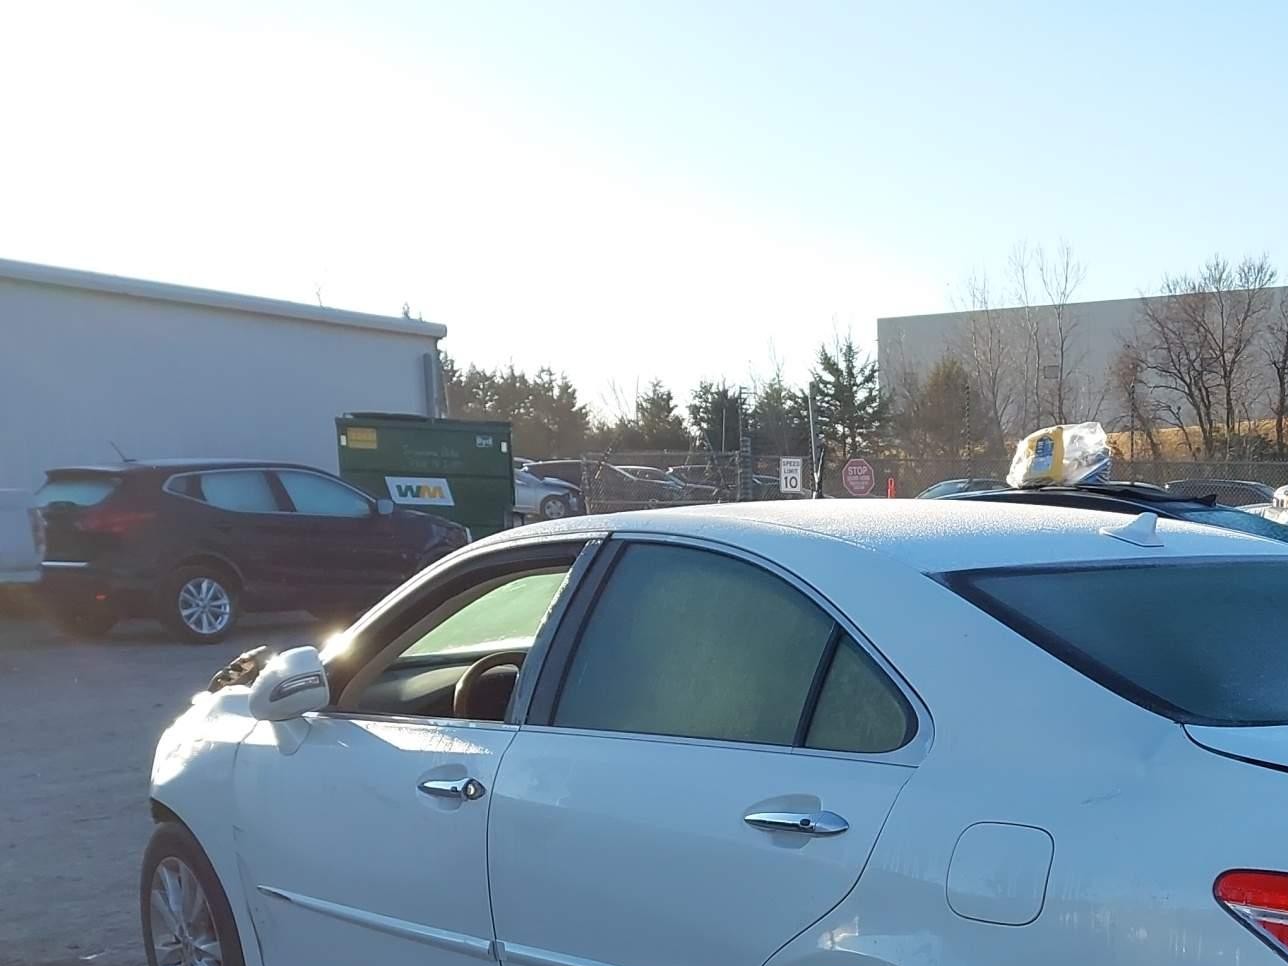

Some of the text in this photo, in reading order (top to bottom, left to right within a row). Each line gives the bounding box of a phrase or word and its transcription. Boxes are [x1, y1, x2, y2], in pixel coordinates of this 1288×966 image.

[847, 466, 868, 475] STOP
[783, 476, 798, 489] 10
[396, 484, 443, 498] WM
